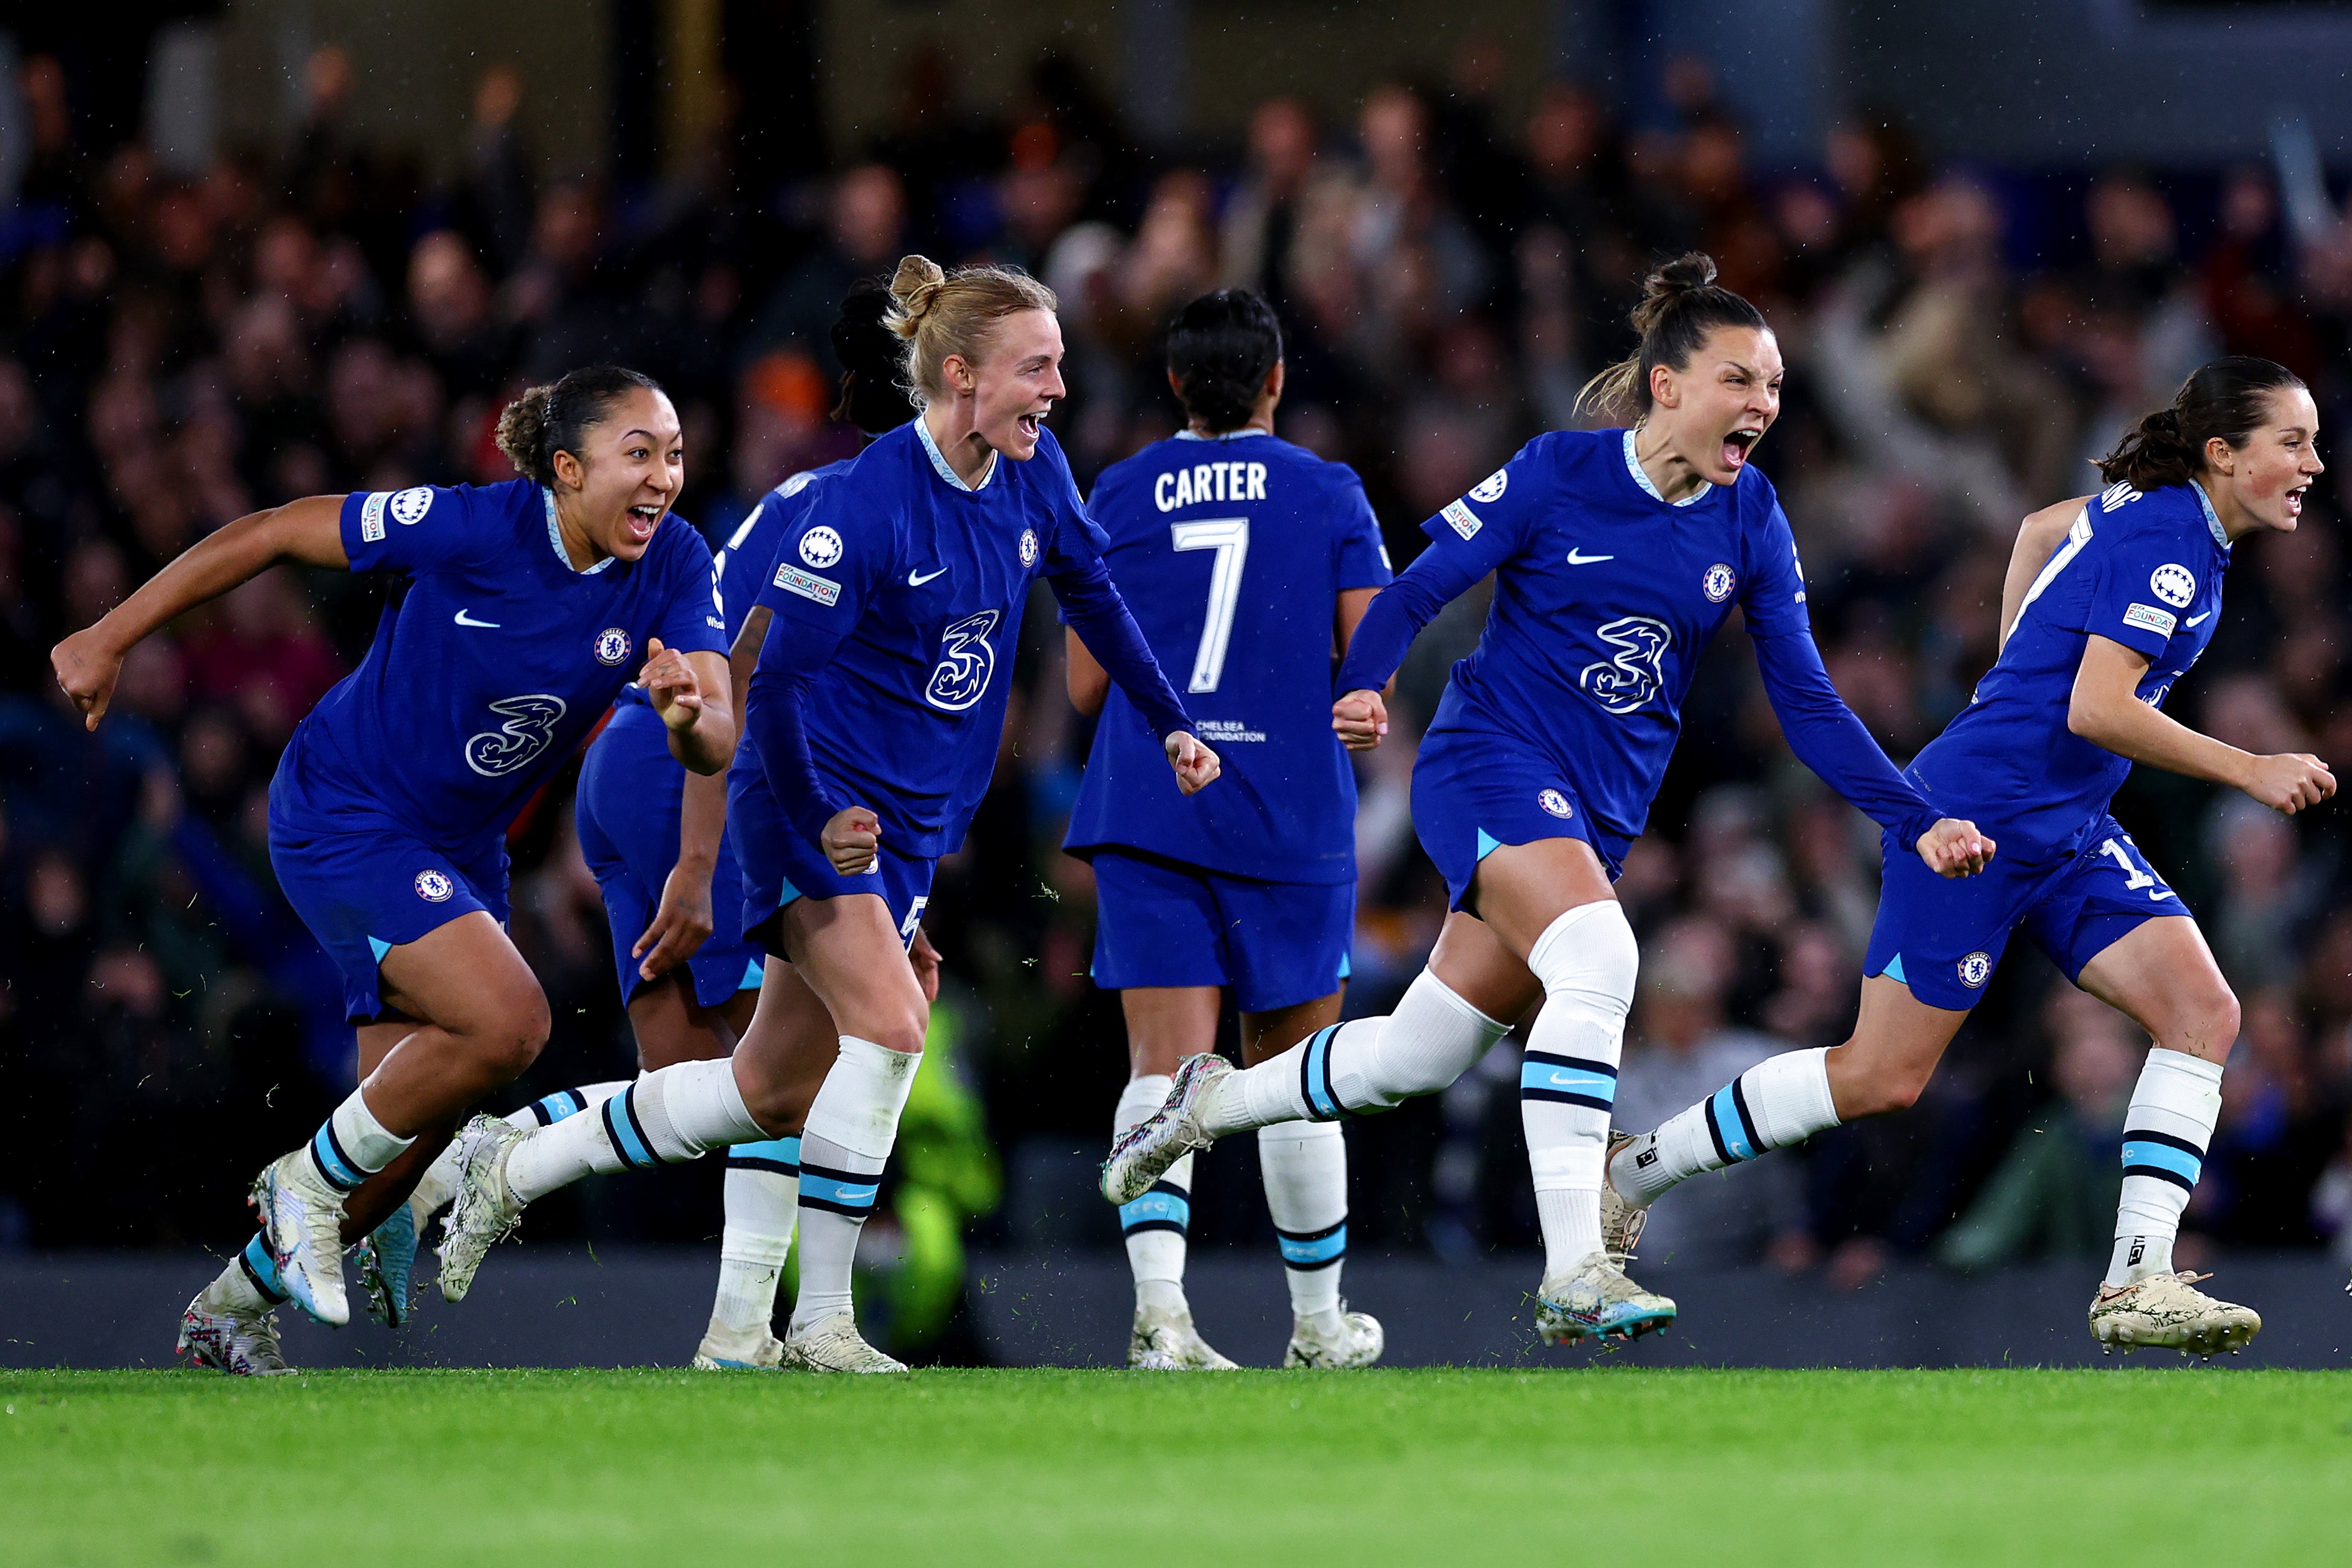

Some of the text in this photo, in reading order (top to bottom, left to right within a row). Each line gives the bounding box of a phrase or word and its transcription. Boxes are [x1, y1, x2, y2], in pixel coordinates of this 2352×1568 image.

[1155, 462, 1267, 513] CARTER
[777, 570, 837, 599] FOUNDATION
[1170, 516, 1250, 694] 7
[1195, 720, 1245, 731] CHELSEA
[1201, 732, 1267, 743] OUNDATION
